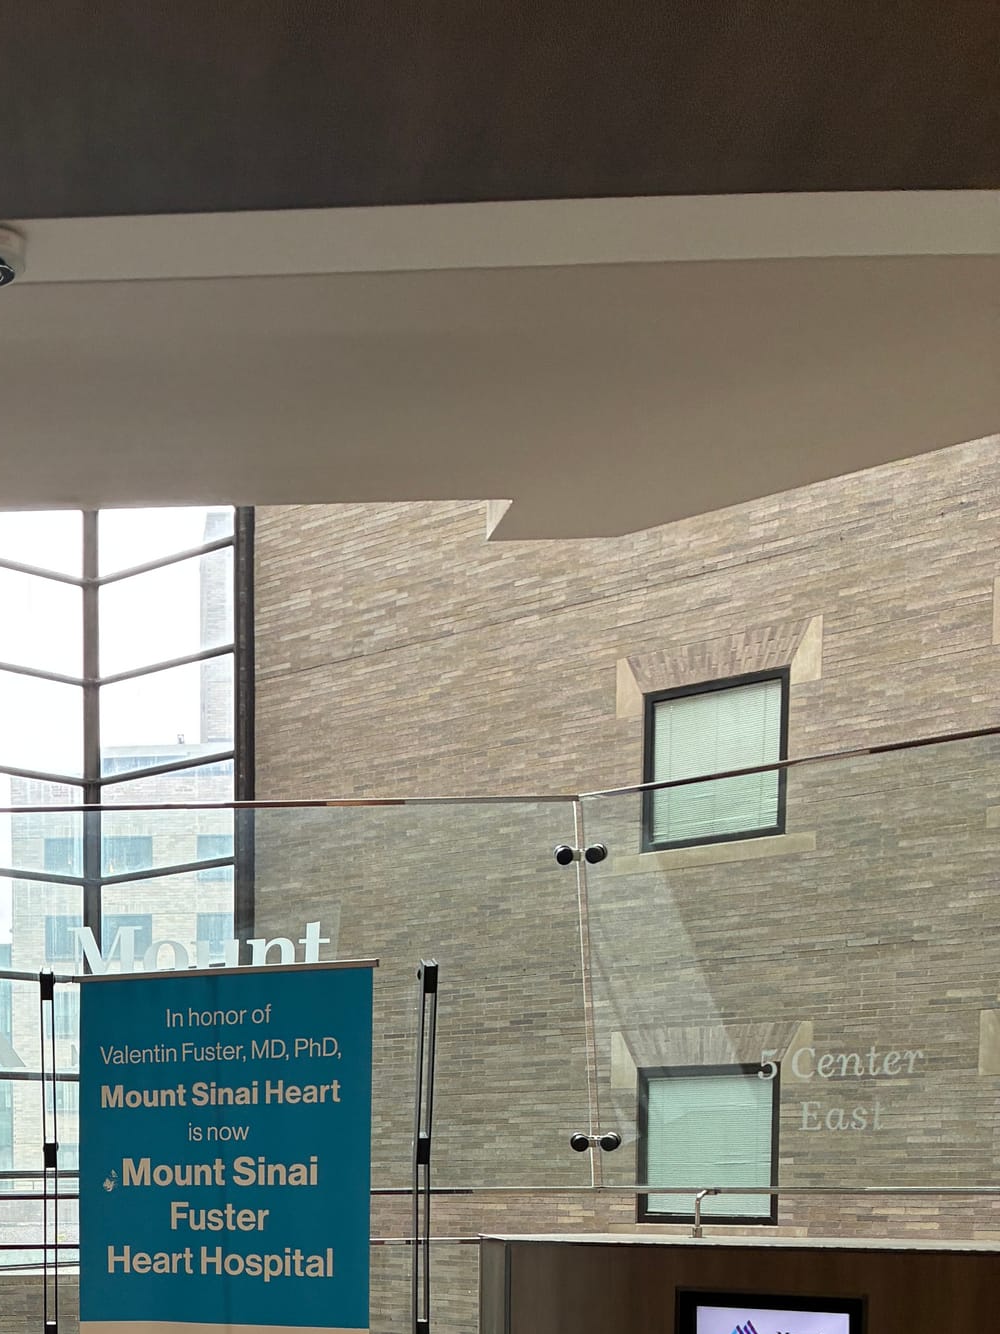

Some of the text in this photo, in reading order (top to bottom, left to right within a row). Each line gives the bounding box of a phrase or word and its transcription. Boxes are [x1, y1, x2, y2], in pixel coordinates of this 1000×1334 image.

[166, 1003, 272, 1028] In honor of
[100, 1044, 177, 1065] Valentin
[181, 1042, 247, 1064] Fuster,
[251, 1039, 290, 1061] MD,
[294, 1036, 342, 1060] PhD,
[758, 1046, 924, 1080] 5 Center
[101, 1079, 341, 1109] Mount Sinai Heart
[798, 1100, 883, 1131] East
[188, 1122, 250, 1142] is now
[122, 1155, 319, 1187] Mount Sinai
[170, 1201, 270, 1231] Fuster
[107, 1245, 334, 1283] Heart Hospital
